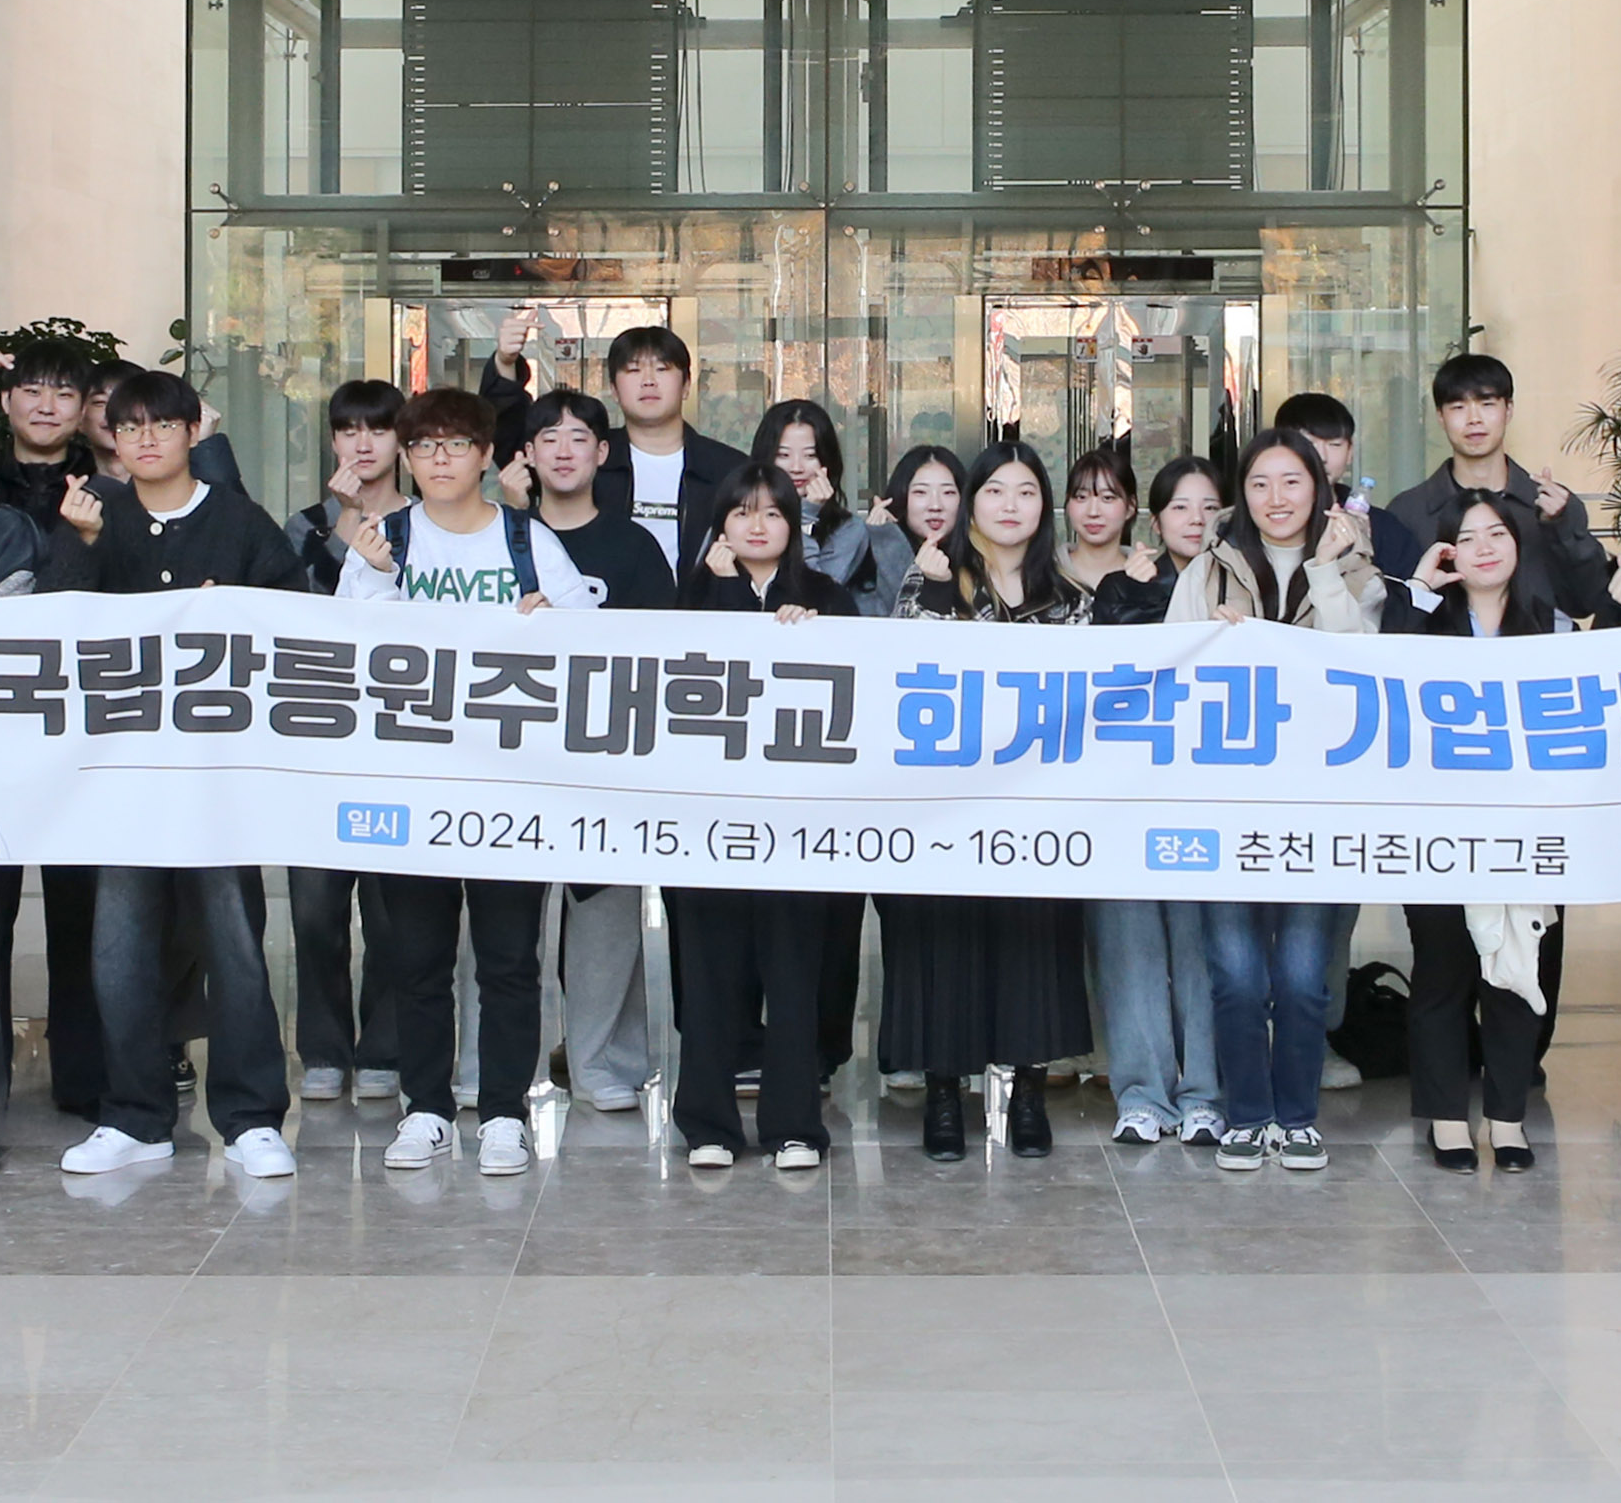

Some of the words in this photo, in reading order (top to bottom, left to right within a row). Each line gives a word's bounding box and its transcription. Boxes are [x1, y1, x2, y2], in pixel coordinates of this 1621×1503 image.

[893, 662, 1292, 768] 회계학과
[346, 808, 399, 840] 일시
[428, 810, 555, 851] 2024.
[570, 816, 617, 853] 11.
[634, 820, 691, 856] 15.
[707, 820, 776, 863] (금)
[791, 827, 915, 864] 14:00
[969, 829, 1092, 867] 16:00
[1154, 835, 1210, 864] 장소
[1236, 831, 1315, 873] 춘천
[1332, 833, 1569, 876] 더존ICT그룹
